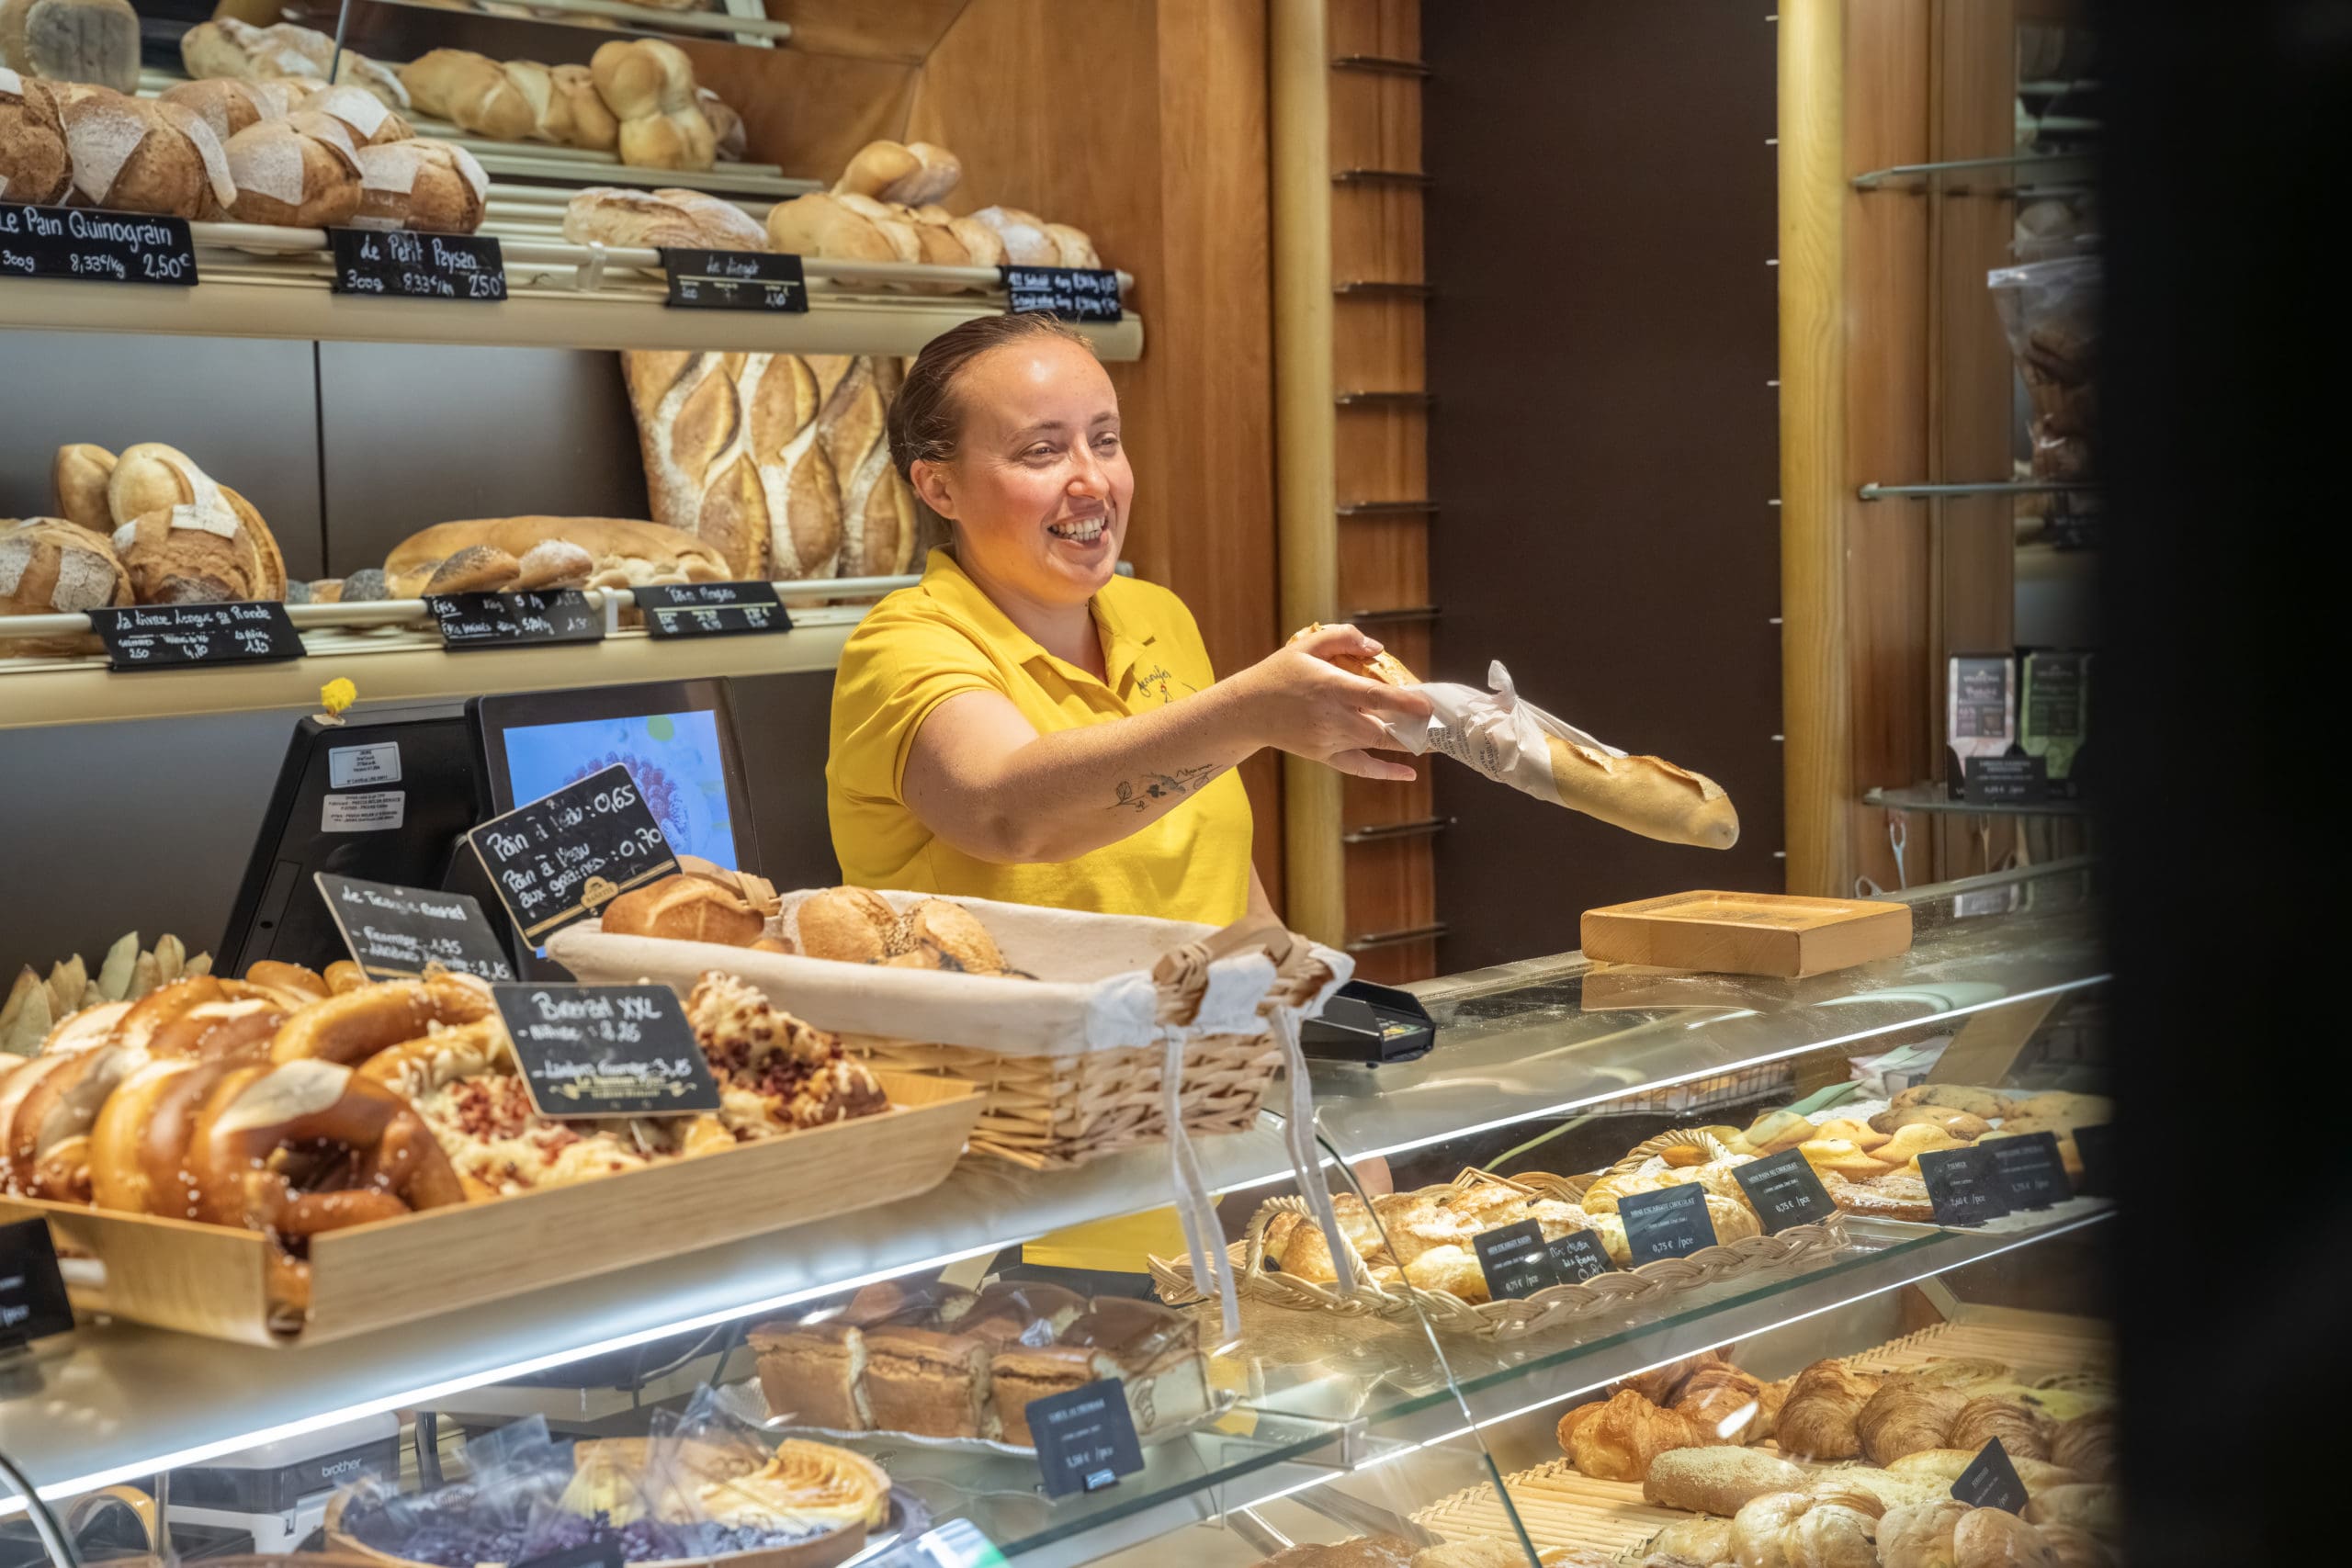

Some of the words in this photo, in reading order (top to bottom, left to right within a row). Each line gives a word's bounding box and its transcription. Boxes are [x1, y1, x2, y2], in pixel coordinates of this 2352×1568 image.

[23, 207, 62, 235] Pain
[69, 210, 172, 253] Quinograin
[3, 250, 35, 272] 300g
[388, 231, 423, 263] Petit
[432, 238, 477, 274] Paysan
[487, 833, 529, 862] Pain
[594, 784, 636, 813] 0,65
[503, 869, 537, 893] Pain
[518, 887, 547, 908] aux
[617, 996, 662, 1021] XXL
[1678, 1235, 1695, 1249] /pce
[322, 1458, 361, 1478] brother
